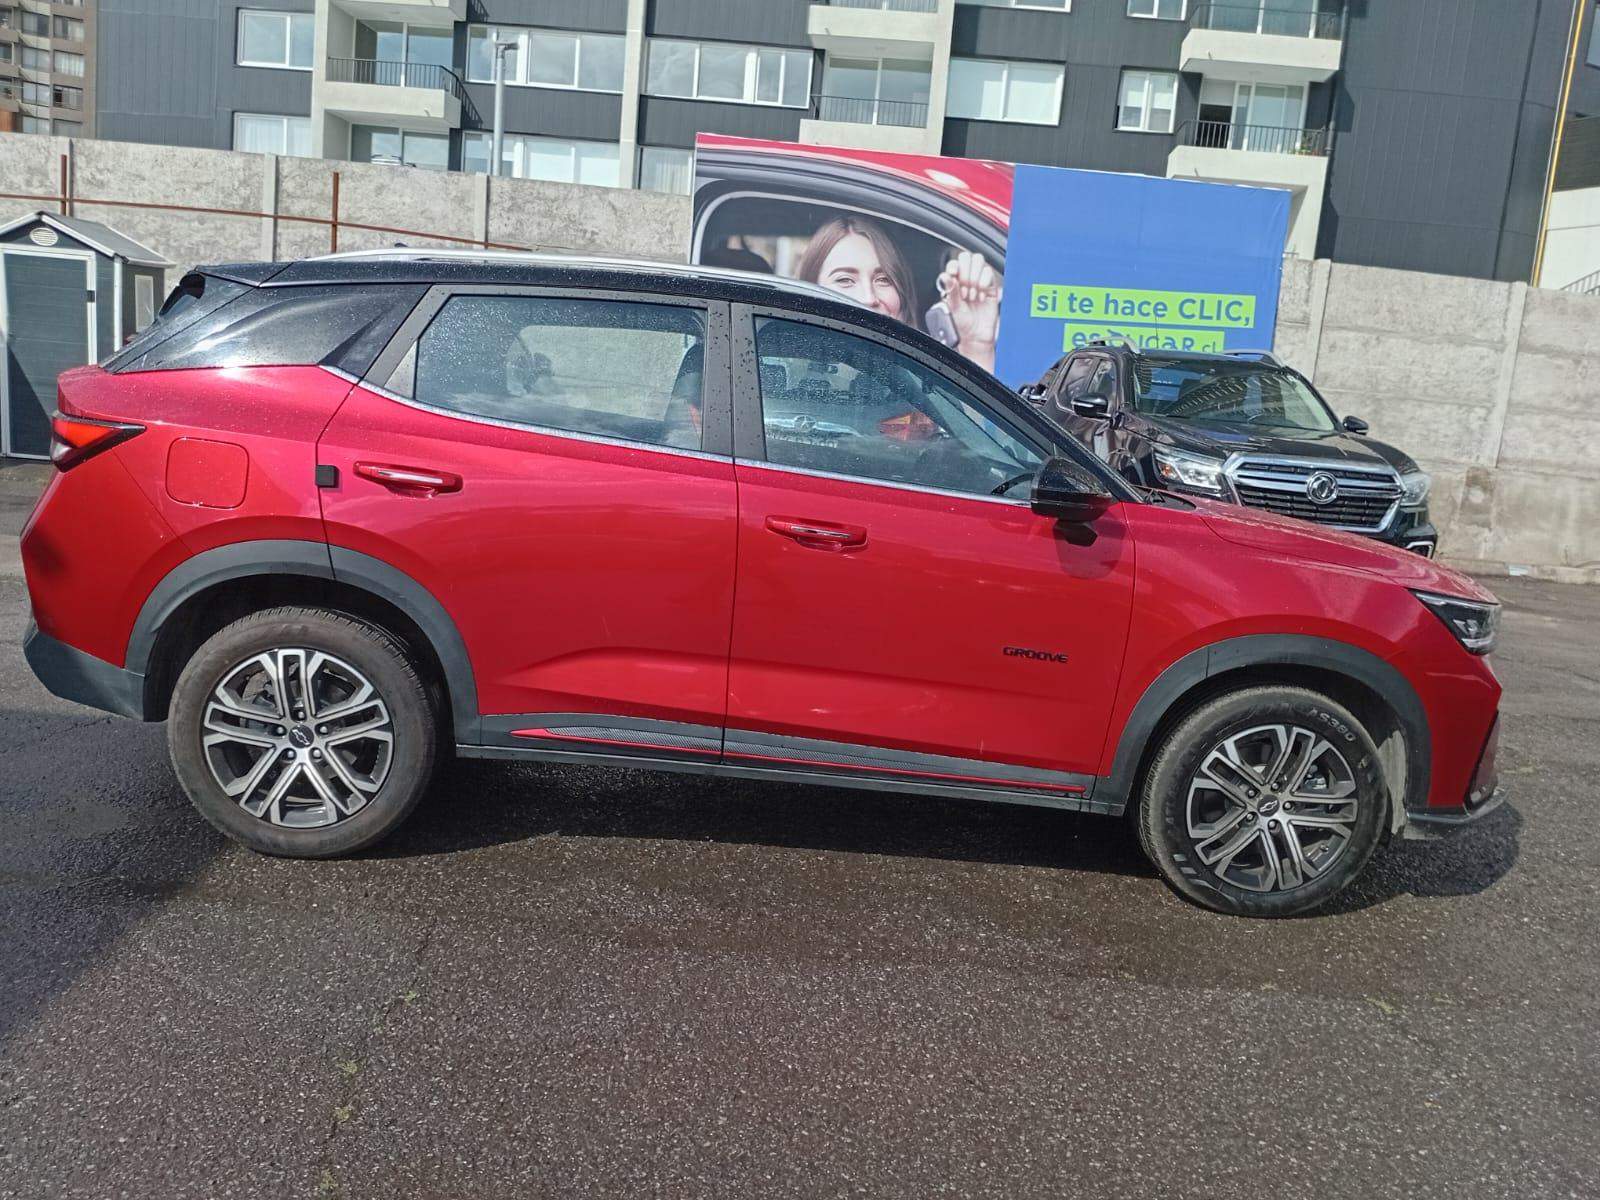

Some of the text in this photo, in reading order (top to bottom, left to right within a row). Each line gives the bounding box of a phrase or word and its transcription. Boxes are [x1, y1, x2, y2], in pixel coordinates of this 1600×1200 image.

[1036, 290, 1251, 327] si te hace CLIC,
[1003, 646, 1069, 664] GROOVE
